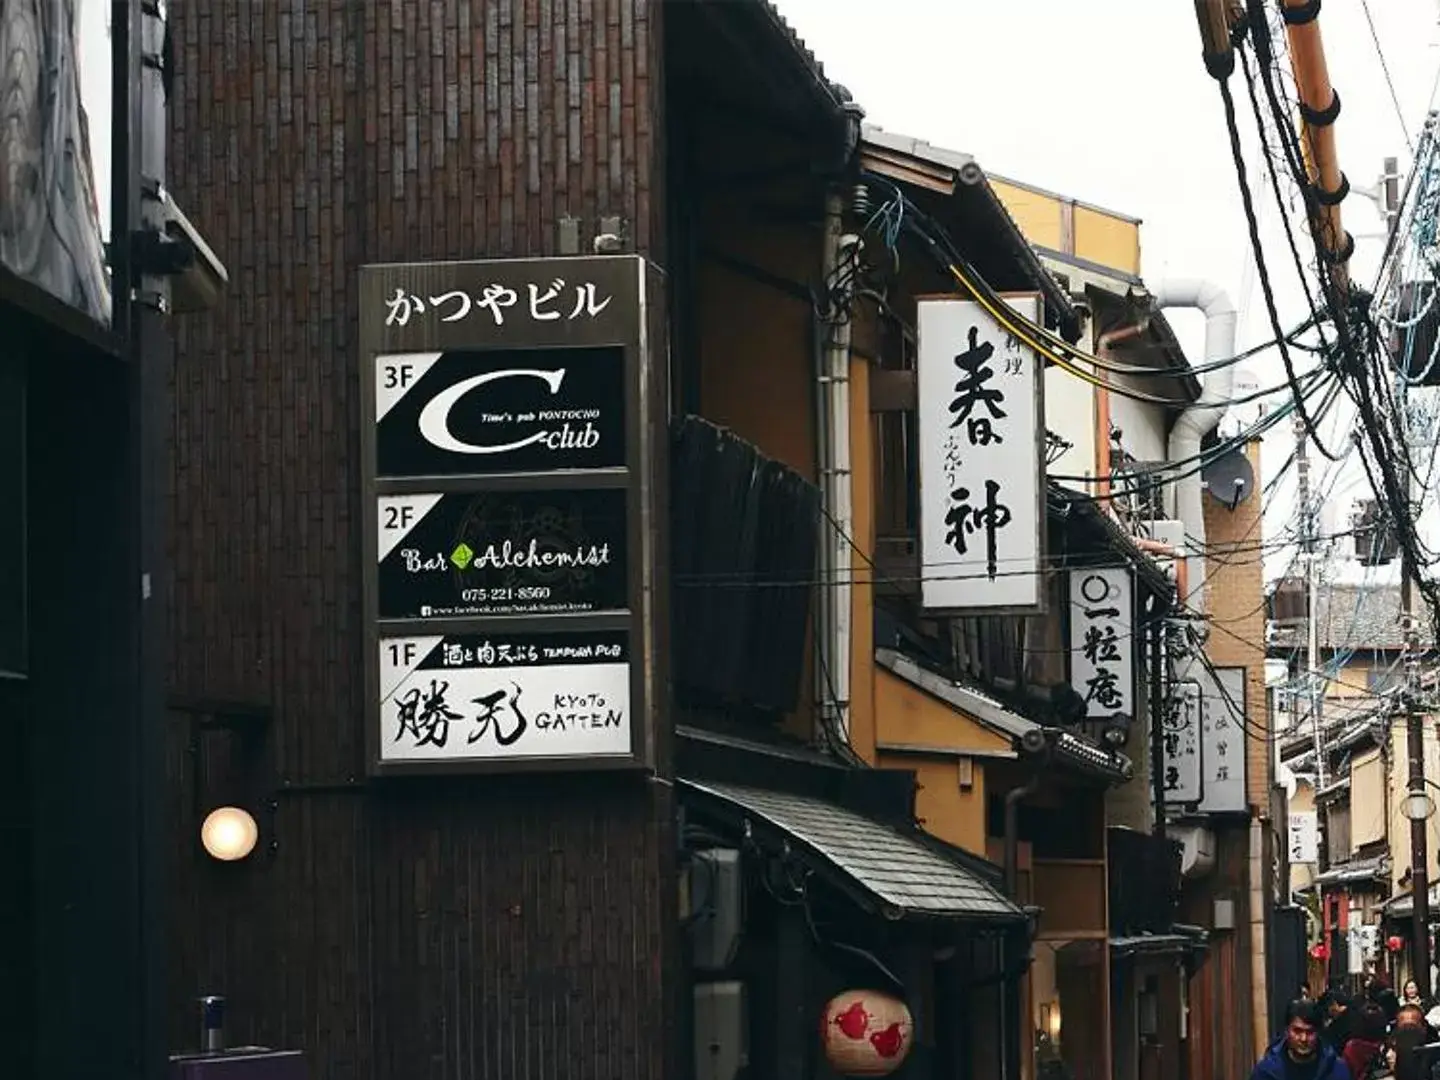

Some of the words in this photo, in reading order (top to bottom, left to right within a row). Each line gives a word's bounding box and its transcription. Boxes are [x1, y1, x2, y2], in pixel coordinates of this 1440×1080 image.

[385, 278, 613, 328] かつやビル
[384, 365, 413, 389] 3F
[517, 412, 537, 424] pub
[538, 408, 600, 421] PONTOCHO
[384, 506, 414, 529] 2F
[401, 548, 448, 573] Bar
[474, 538, 611, 569] Alchemist
[388, 643, 416, 667] 1F
[543, 646, 592, 658] TEMPURA
[594, 643, 622, 657] PUB
[1081, 607, 1123, 709] 一粒庵
[535, 709, 623, 731] GATTEN
